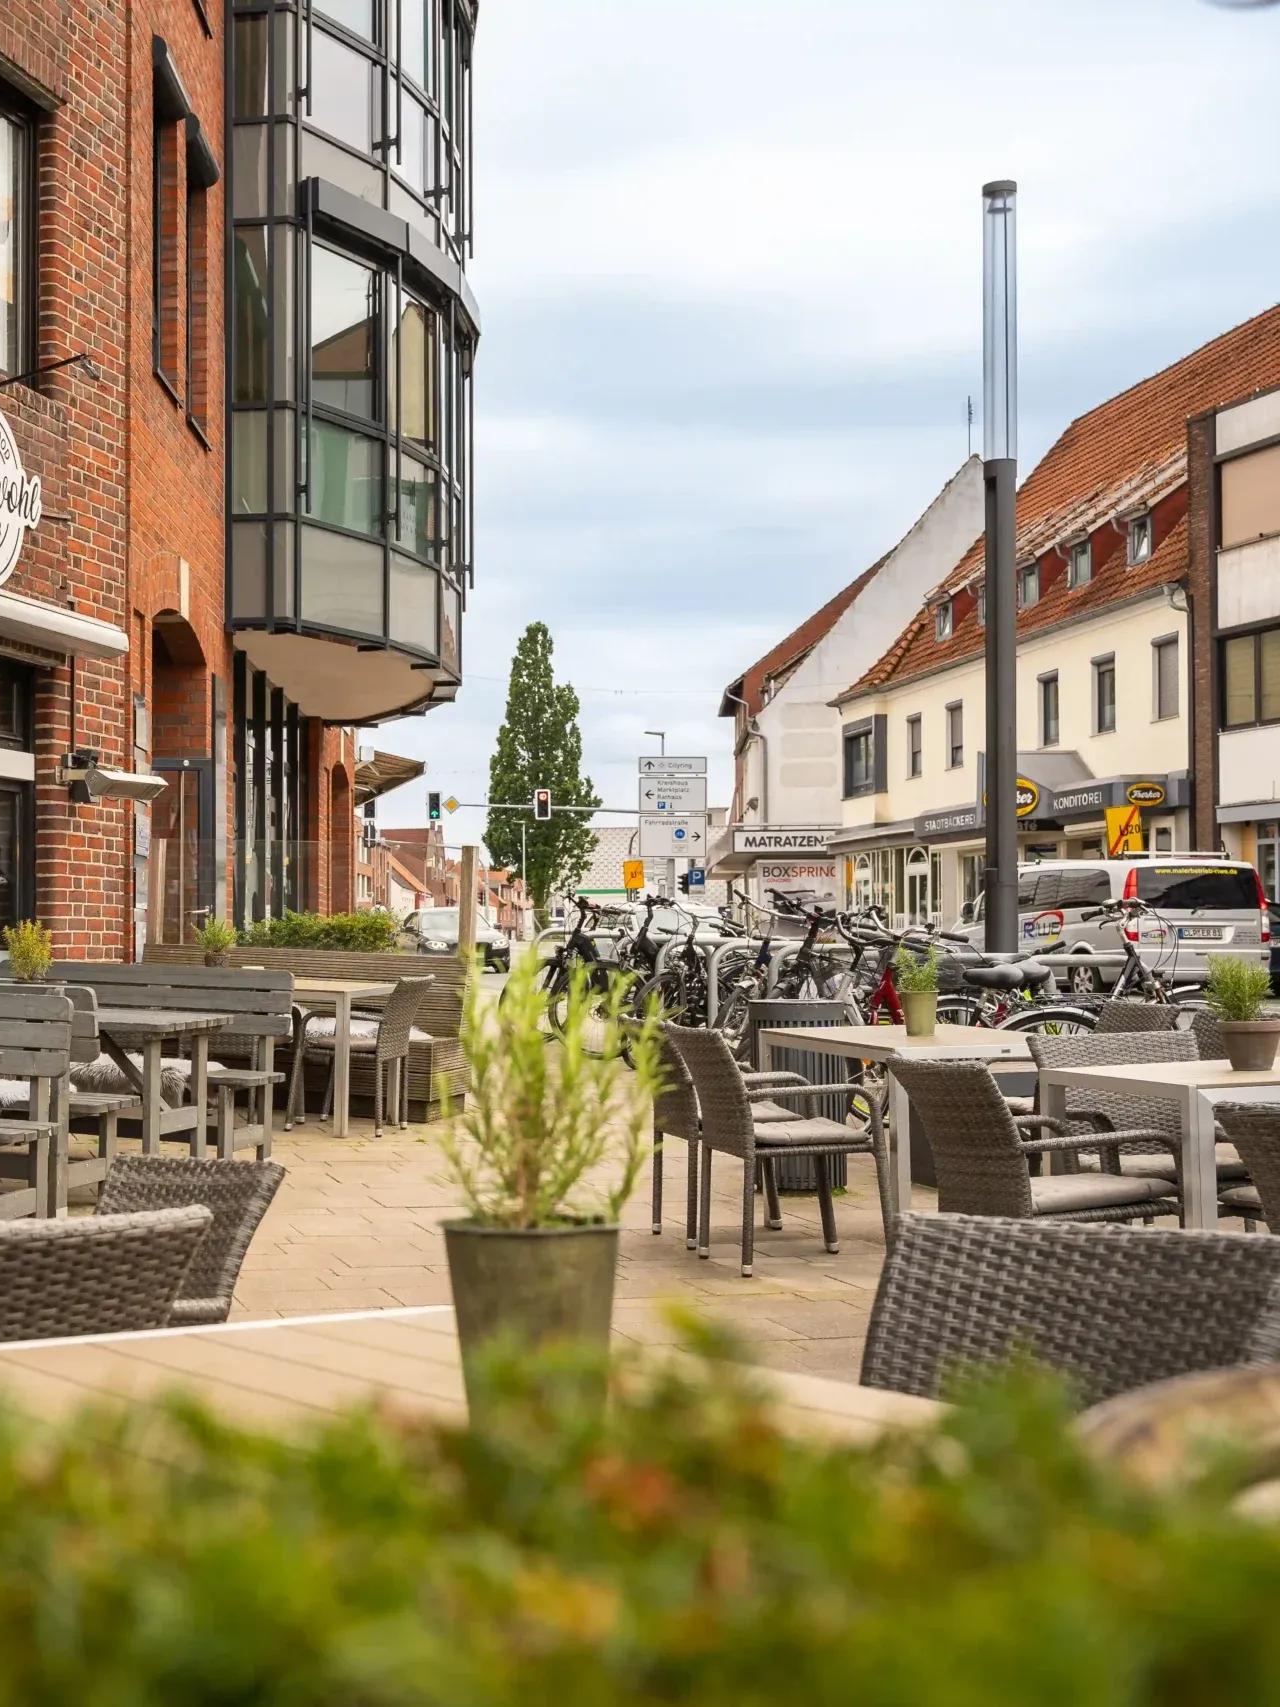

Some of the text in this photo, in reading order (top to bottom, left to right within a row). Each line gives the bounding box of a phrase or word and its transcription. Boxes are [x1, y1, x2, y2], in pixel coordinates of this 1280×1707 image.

[1053, 791, 1102, 811] KONDITOREI
[925, 814, 976, 831] STADTBÄCKEREI
[1017, 820, 1038, 831] afé
[744, 836, 825, 847] MATRATZEN
[692, 871, 702, 883] P
